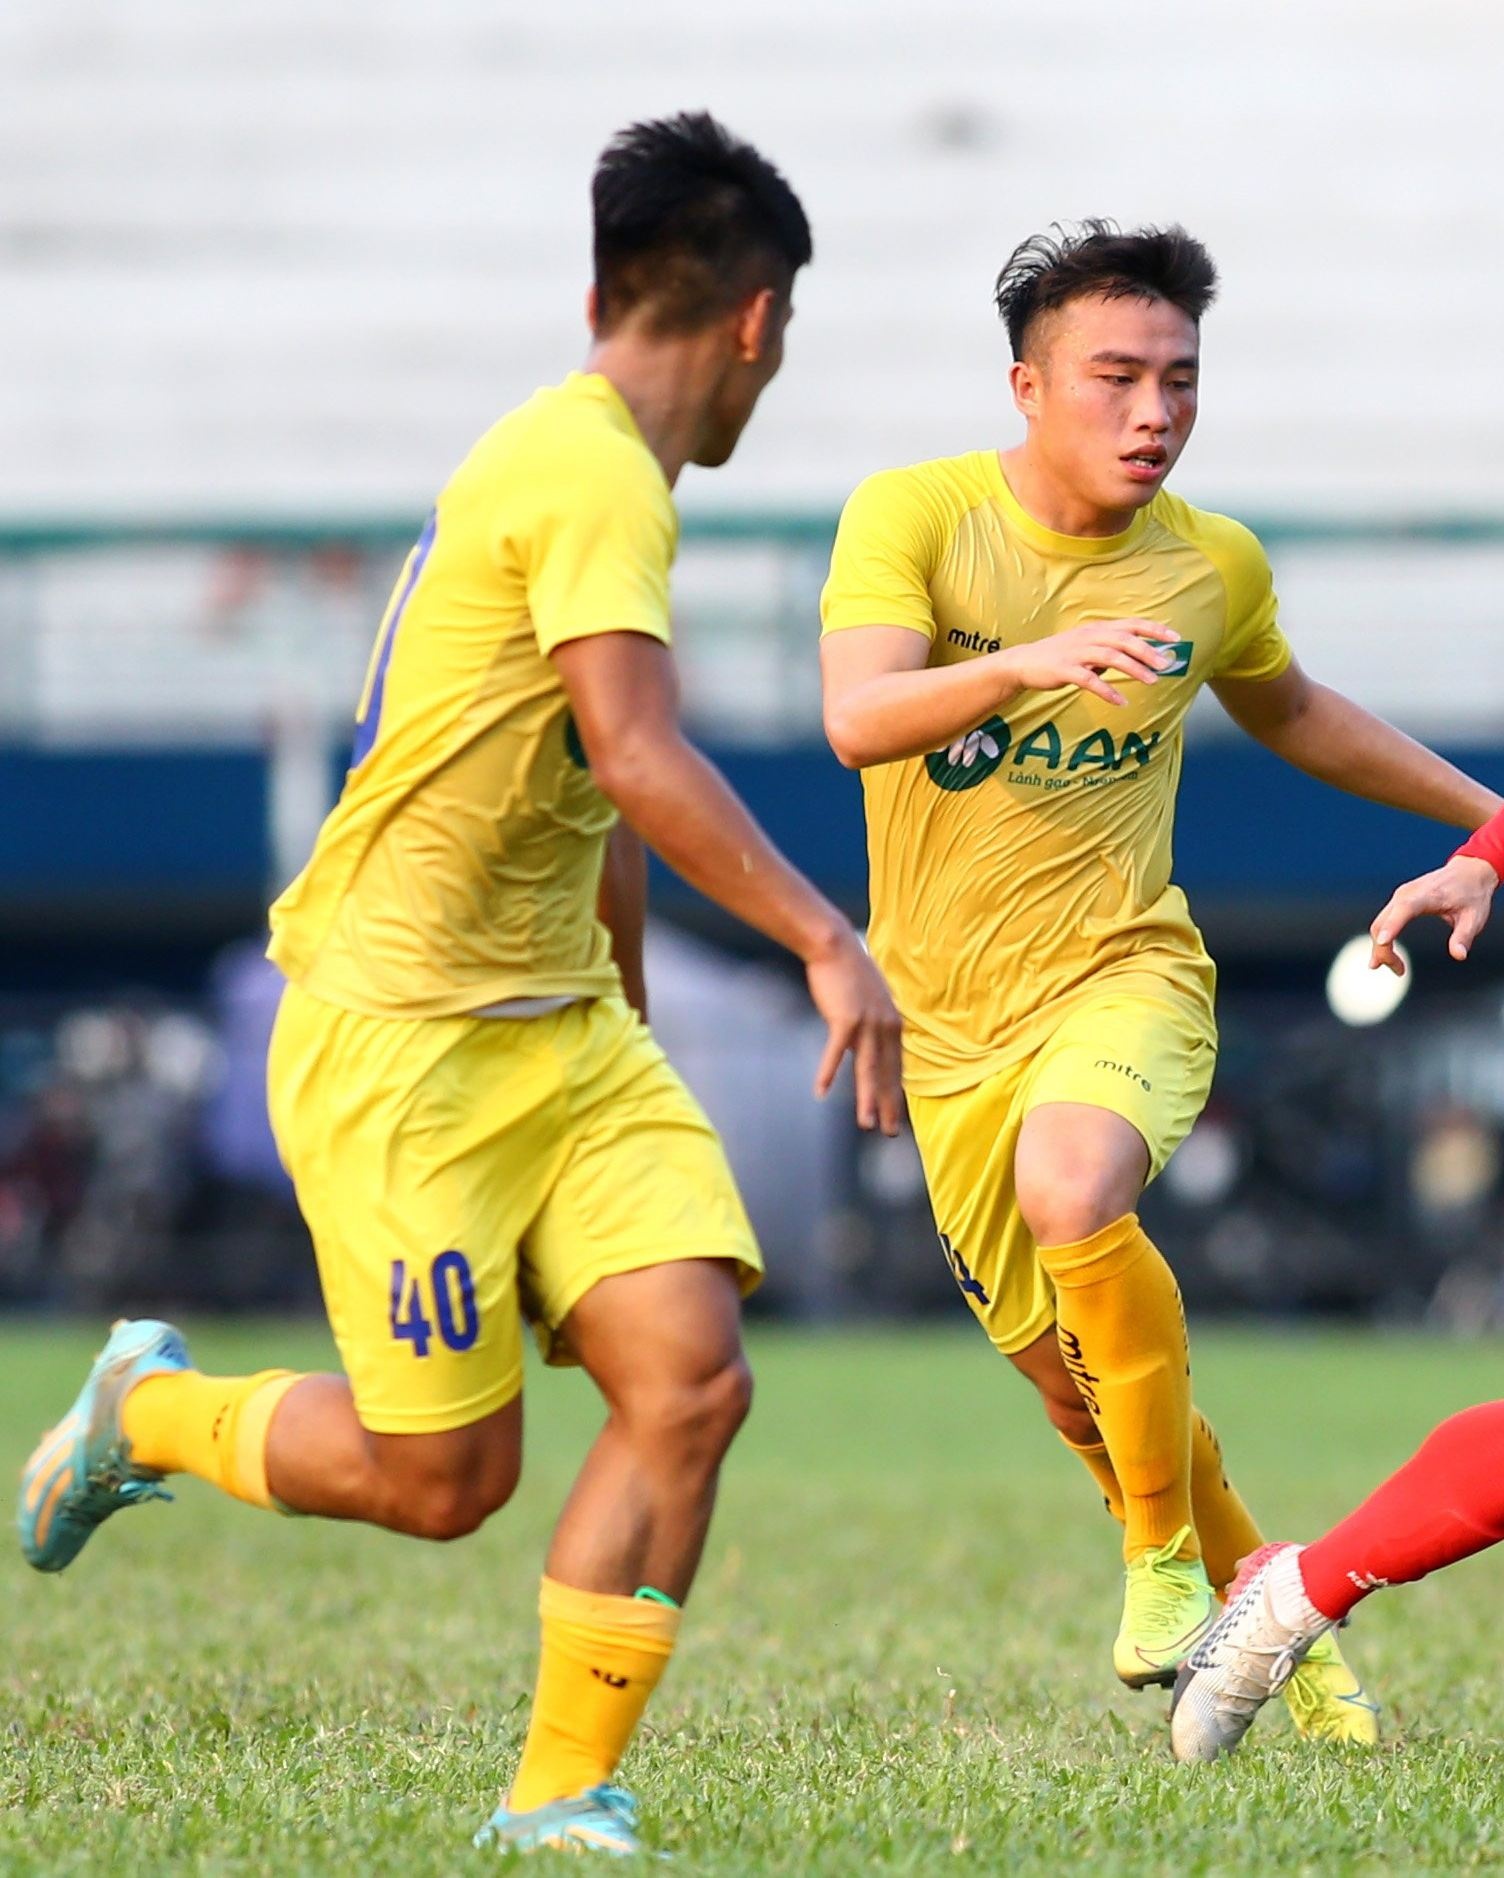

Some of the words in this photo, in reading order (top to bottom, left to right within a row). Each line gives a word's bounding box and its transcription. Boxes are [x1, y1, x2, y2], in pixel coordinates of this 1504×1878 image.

[947, 628, 1000, 653] mitre
[1013, 721, 1160, 770] AAN
[1008, 771, 1041, 786] Lành
[1094, 1060, 1152, 1092] mitre
[390, 1250, 479, 1357] 40
[1059, 1326, 1101, 1415] mitre
